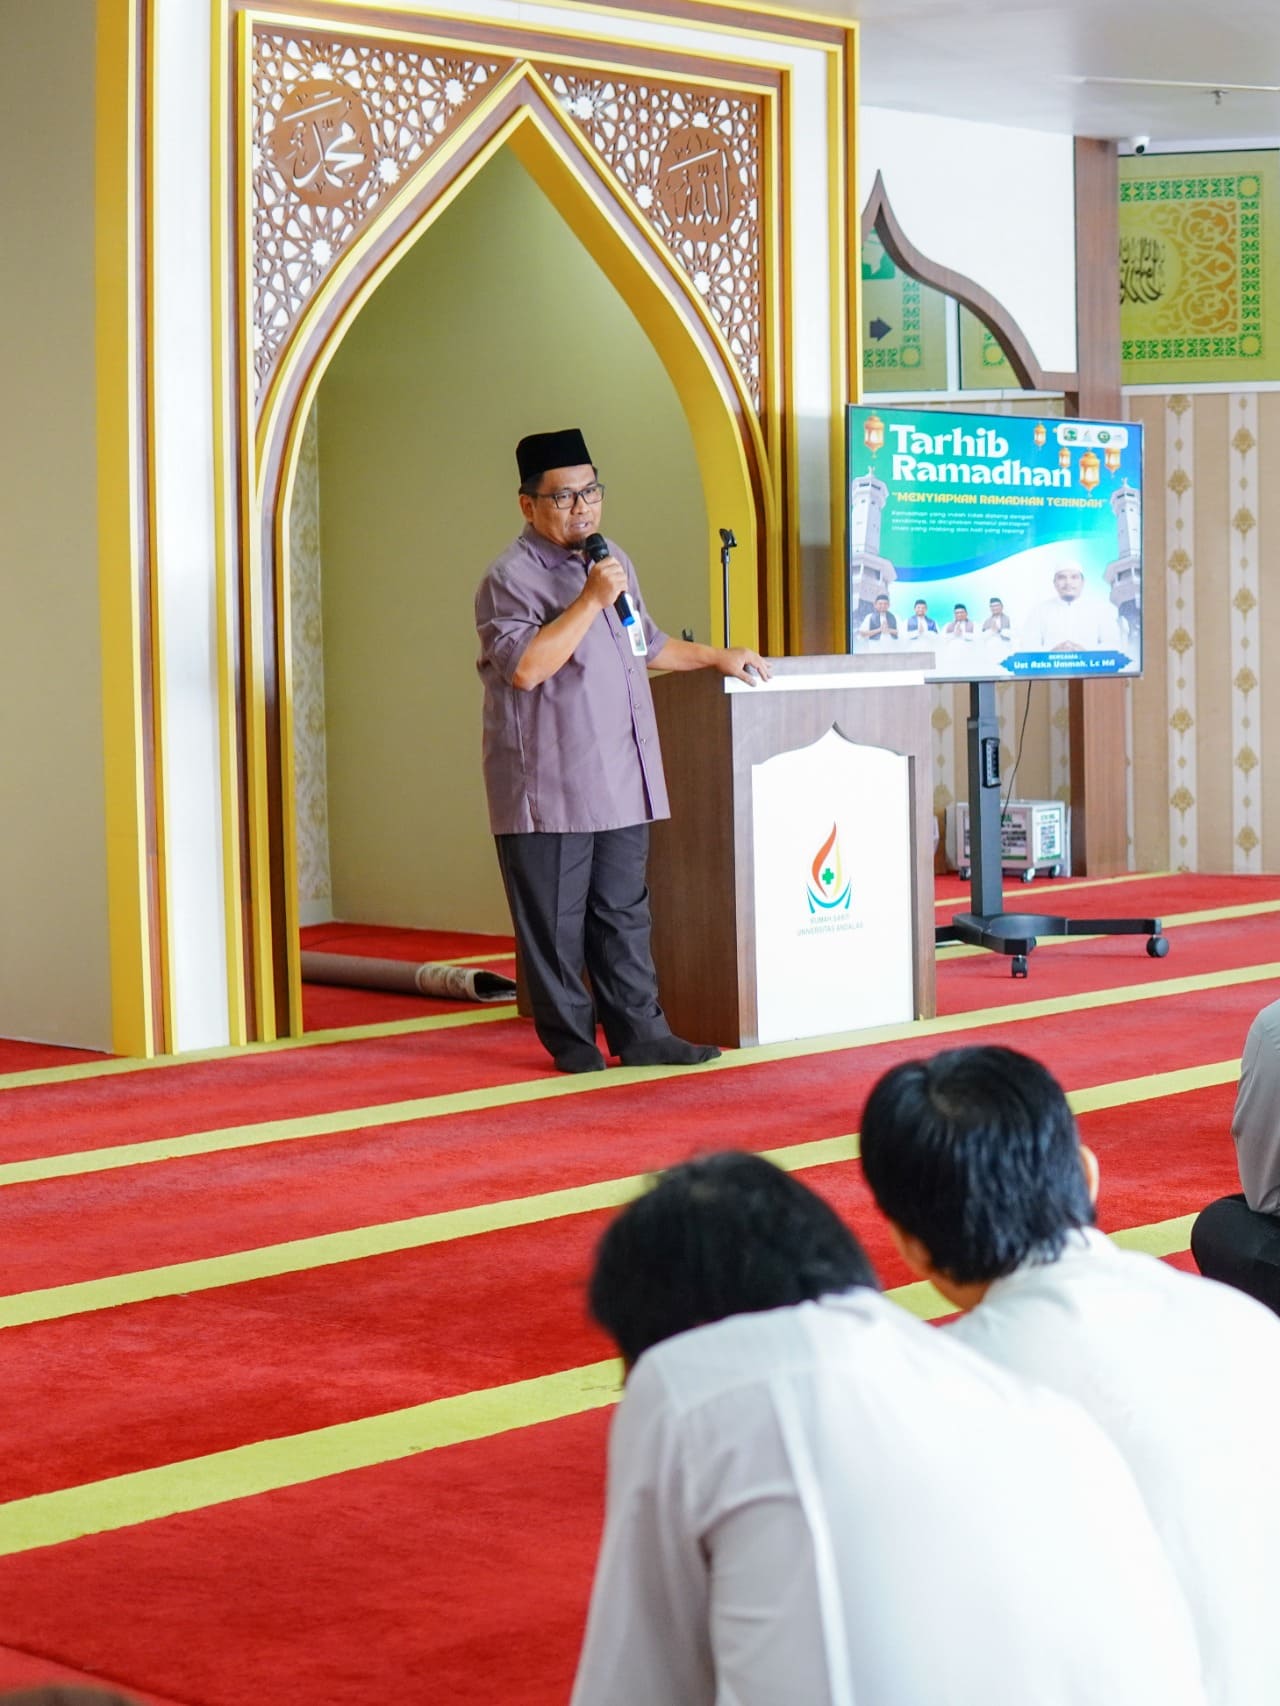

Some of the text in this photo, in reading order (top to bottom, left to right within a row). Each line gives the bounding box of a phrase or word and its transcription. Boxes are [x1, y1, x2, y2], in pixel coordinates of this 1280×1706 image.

[889, 423, 1009, 458] Tarhib
[891, 454, 1072, 487] Ramadhan
[979, 495, 1044, 506] RAMADHAN
